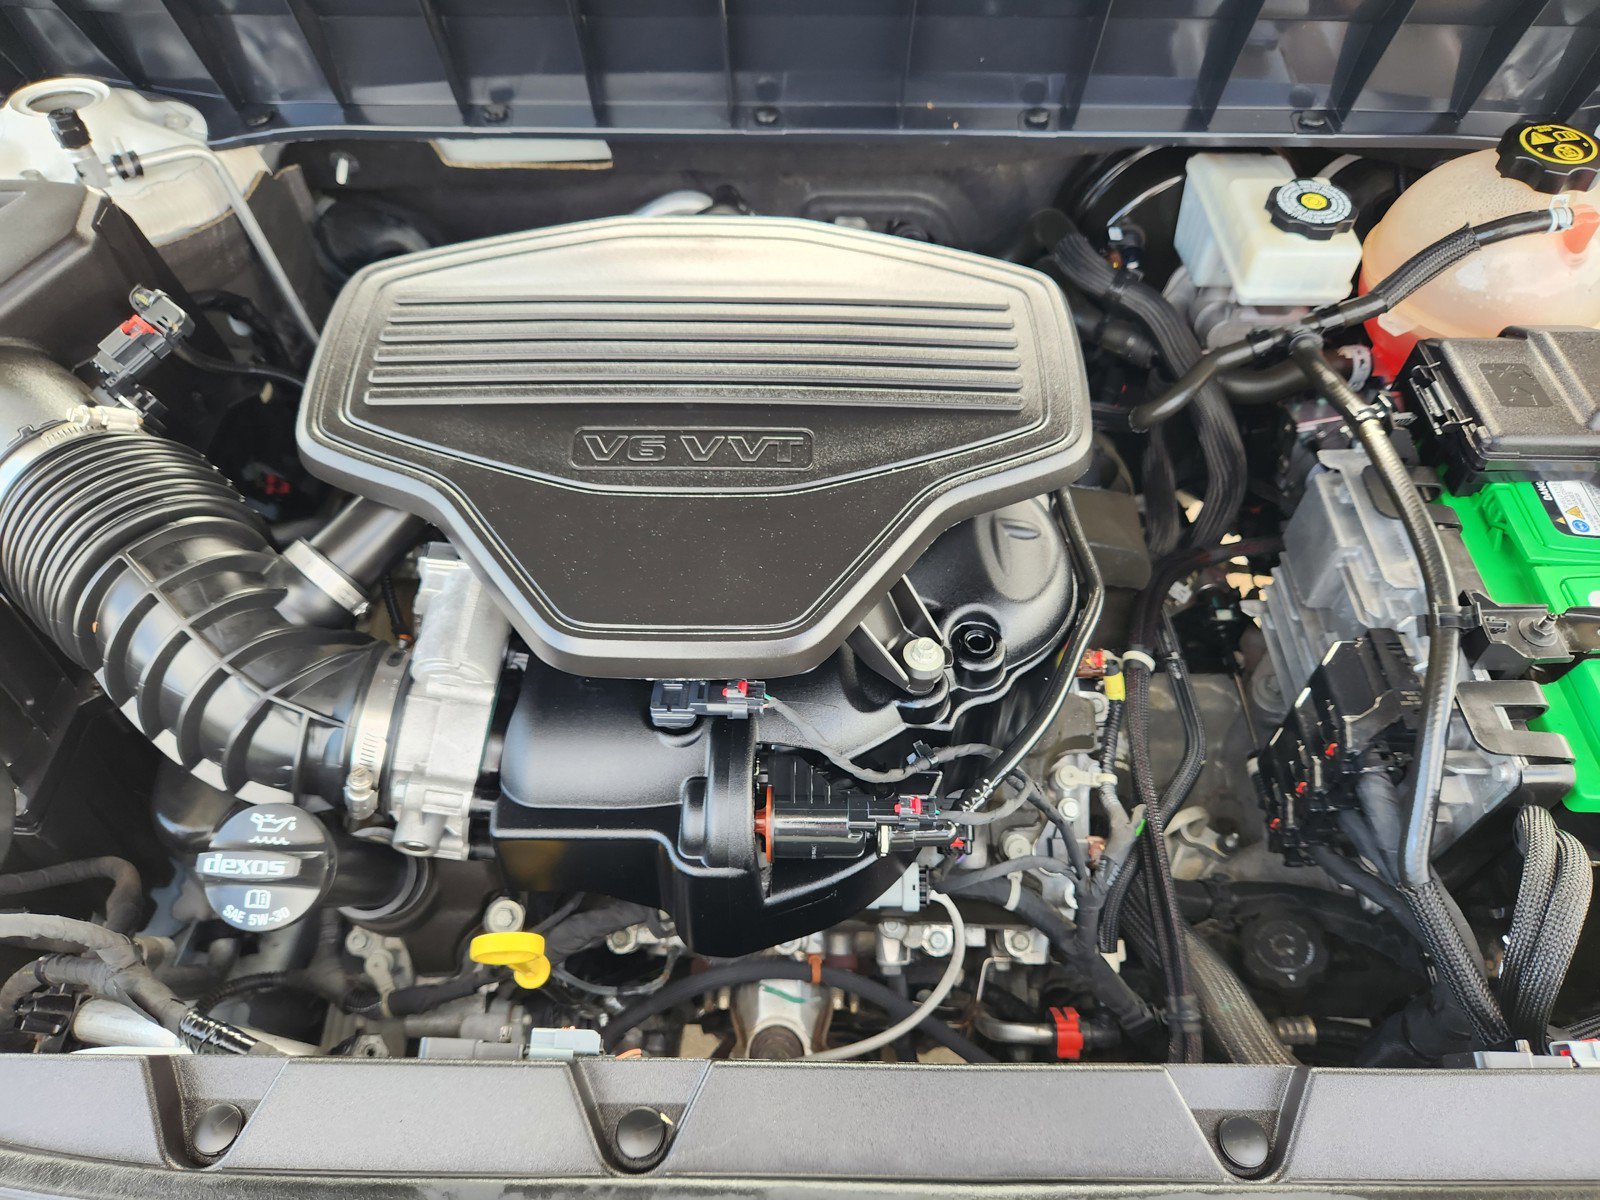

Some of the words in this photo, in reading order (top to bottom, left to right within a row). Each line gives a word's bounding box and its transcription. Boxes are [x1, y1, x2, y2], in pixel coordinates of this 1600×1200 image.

[582, 435, 667, 462] V6
[679, 435, 804, 463] VVT
[204, 854, 289, 875] dexos
[223, 904, 246, 924] SAE
[248, 906, 290, 926] 5W-30
